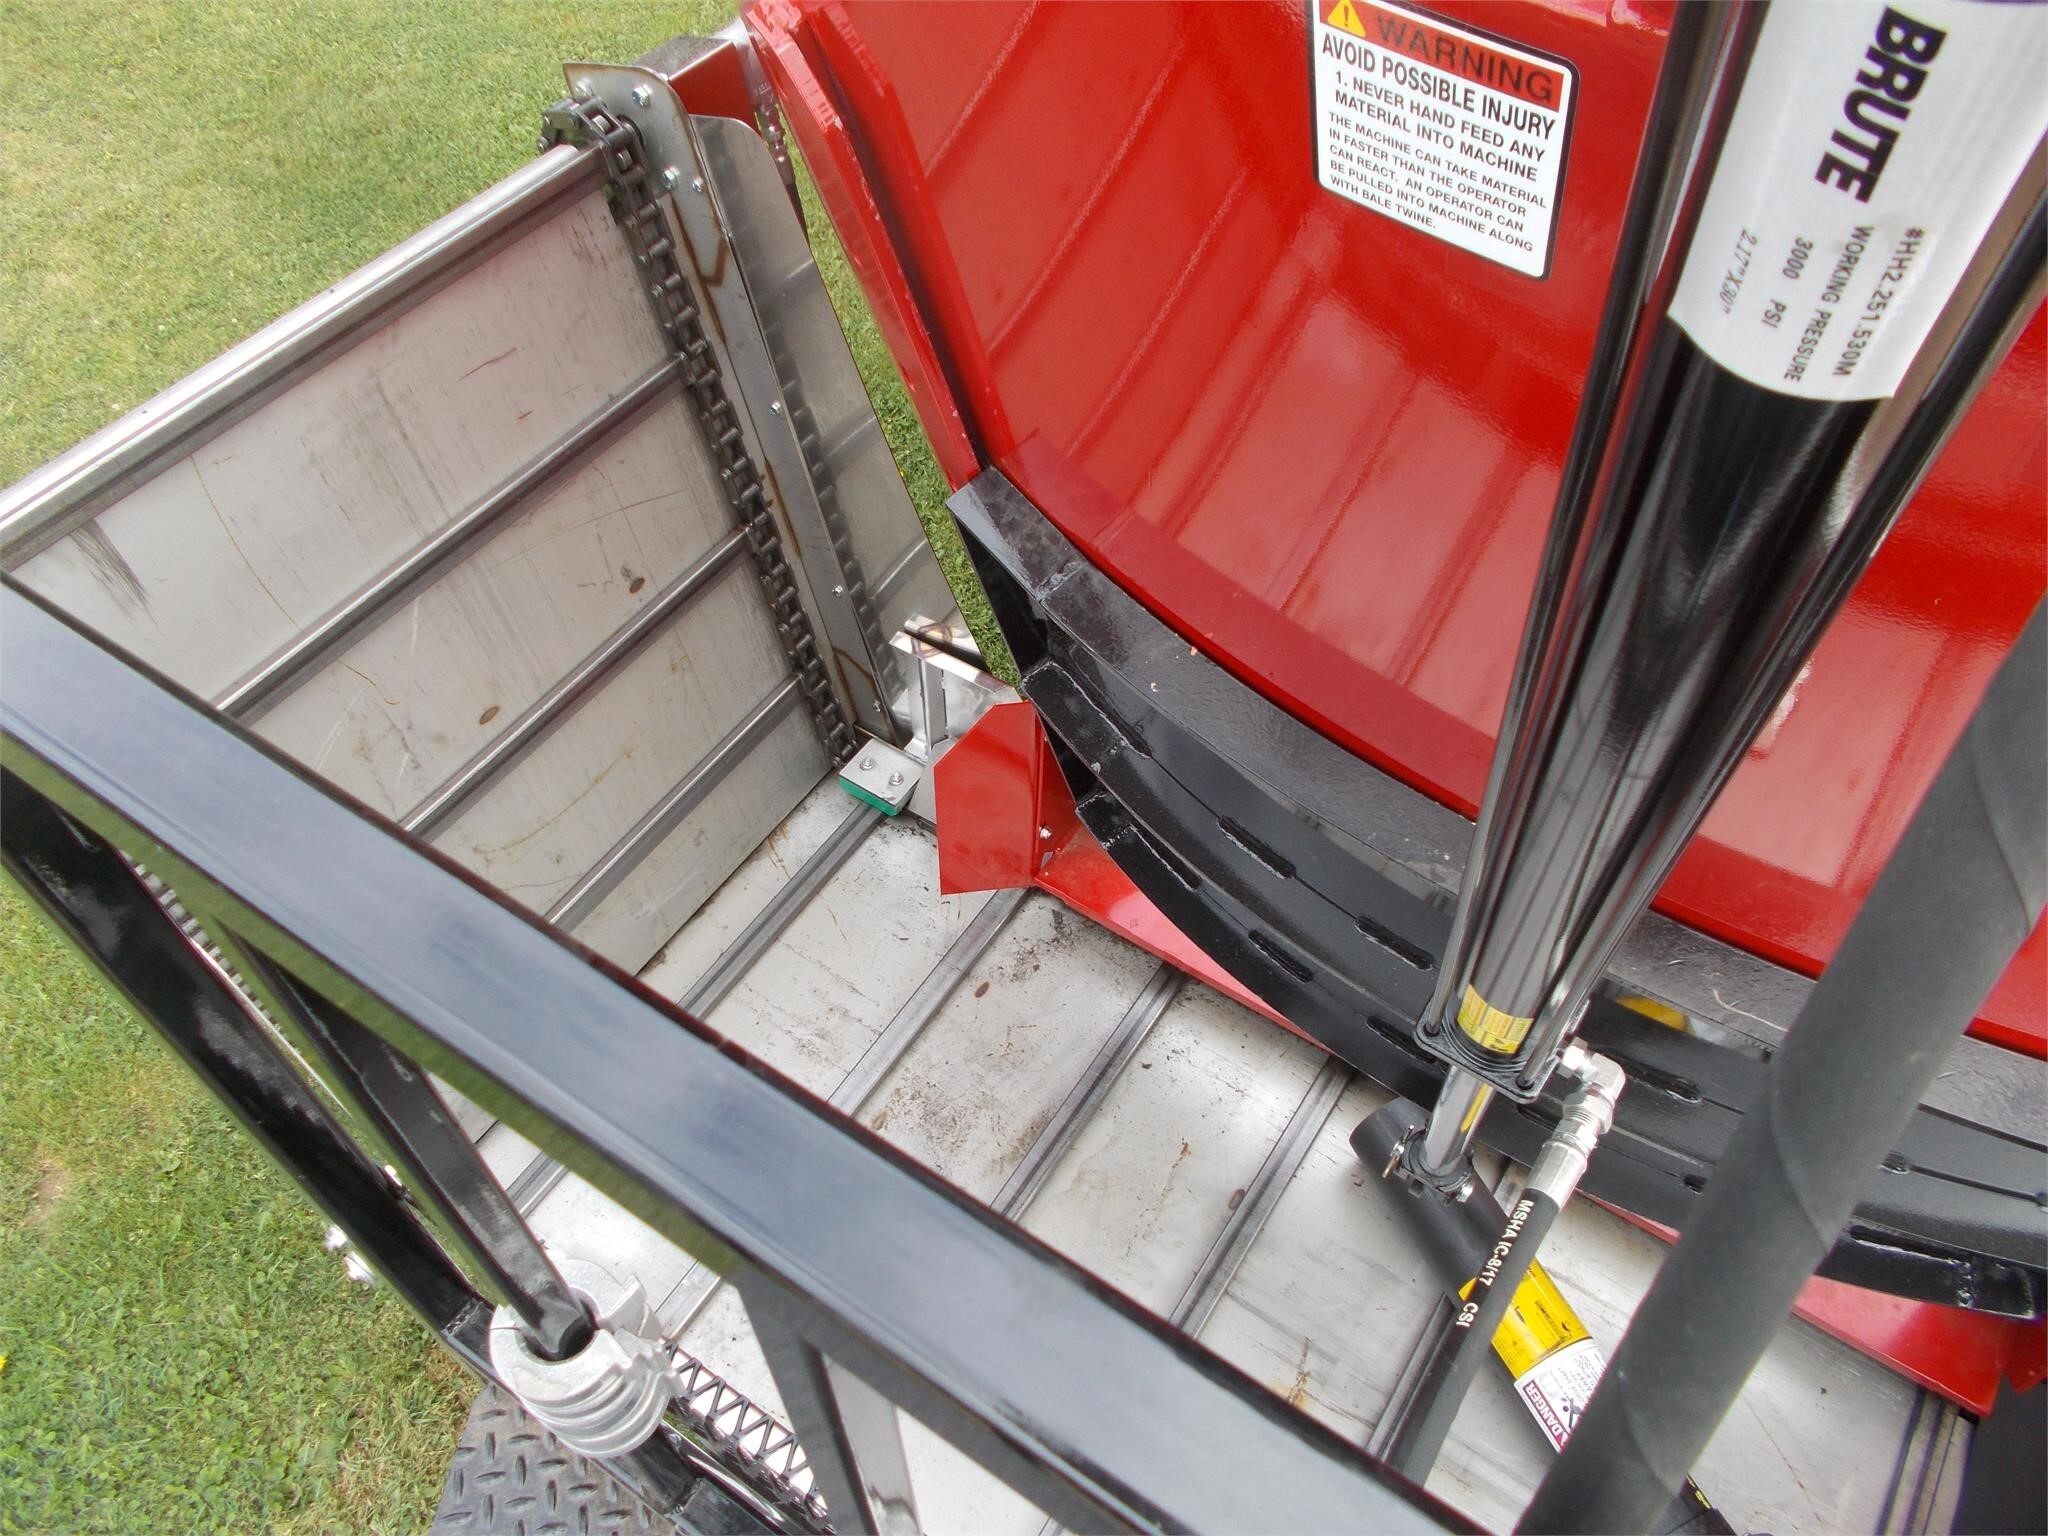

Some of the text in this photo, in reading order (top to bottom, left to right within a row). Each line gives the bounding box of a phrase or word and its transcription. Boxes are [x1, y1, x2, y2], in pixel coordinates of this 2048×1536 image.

[1322, 32, 1556, 140] AVOID POSSIBLE INJURY
[1378, 13, 1553, 104] WARNING
[1335, 70, 1546, 162] 1. NEVER HAND FEED ANY
[1335, 90, 1538, 182] MATERIAL INTO MACHINE
[1814, 7, 1947, 203] BRUTE
[1329, 111, 1547, 208] THE MACHINE CAN TAKE MATERIAL
[1329, 128, 1527, 217] IN FASTER THAN THE OPERATOR
[1330, 144, 1524, 232] CAN REACT. AN OPERATOR CAN
[1330, 174, 1436, 229] WITH BALE TWINE.
[1330, 160, 1534, 251] BE PULLED INTO MACHINE ALONG
[1762, 237, 1813, 328] 3000 PSI
[1783, 225, 1875, 382] WORKING PRESSURE
[1832, 227, 1925, 376] #HH2.251.530M
[1456, 1200, 1534, 1327] MSHA IC-8/17 CSI
[1524, 1383, 1563, 1437] DANGER
